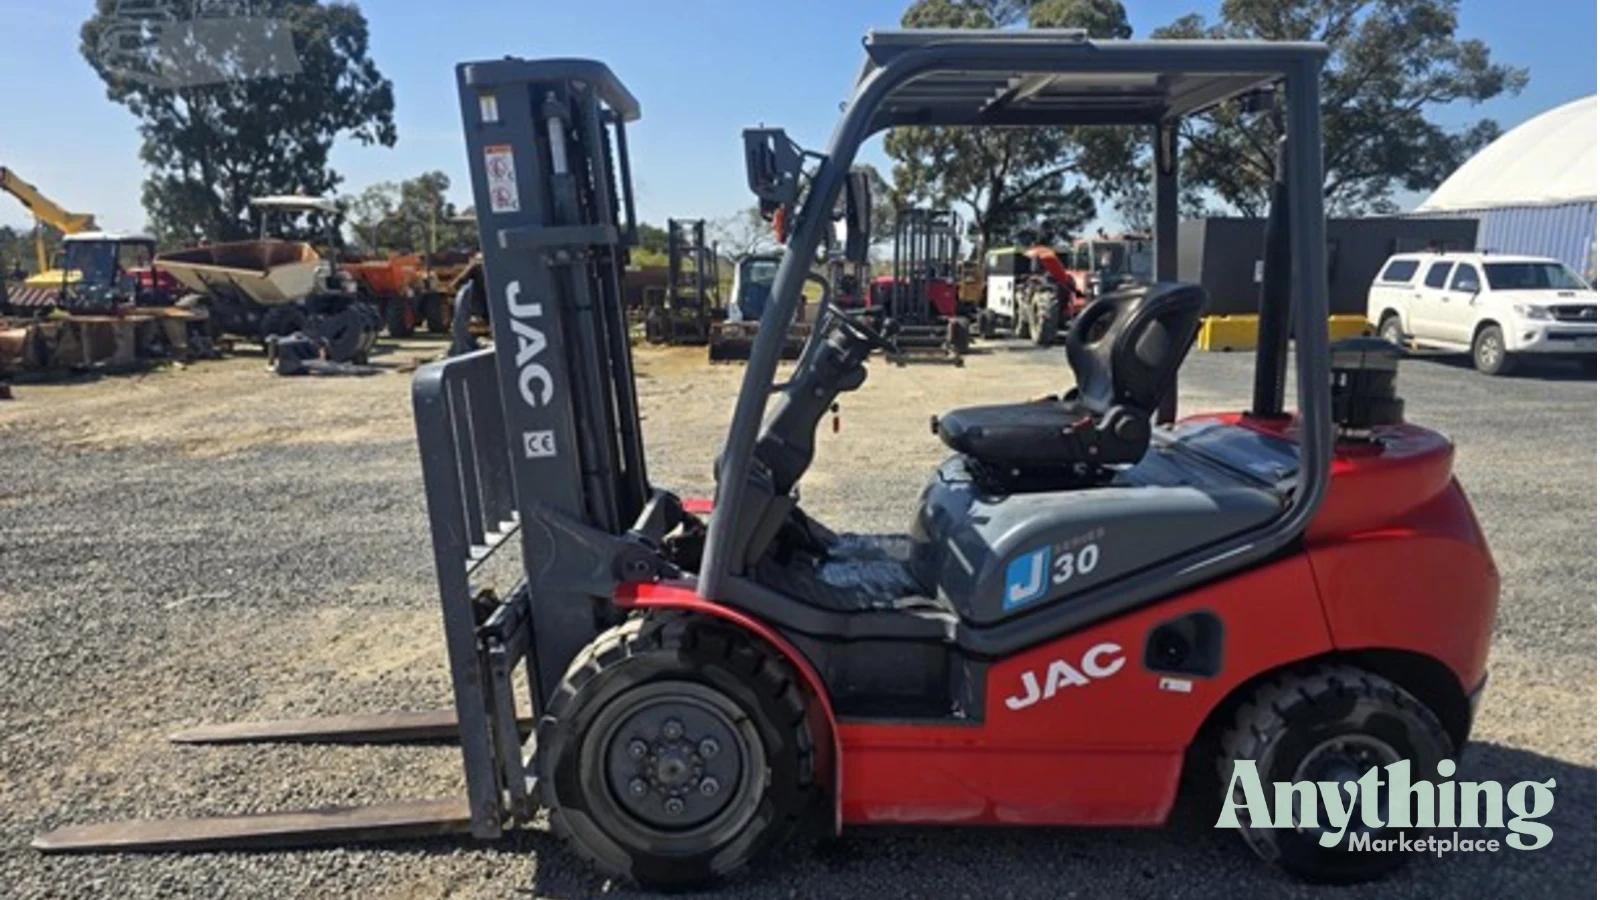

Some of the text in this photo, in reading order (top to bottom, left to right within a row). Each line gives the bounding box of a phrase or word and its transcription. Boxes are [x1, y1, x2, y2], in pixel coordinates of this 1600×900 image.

[505, 281, 554, 408] JAC
[528, 435, 553, 453] CE
[1009, 543, 1099, 601] J 30
[1005, 642, 1126, 710] JAC
